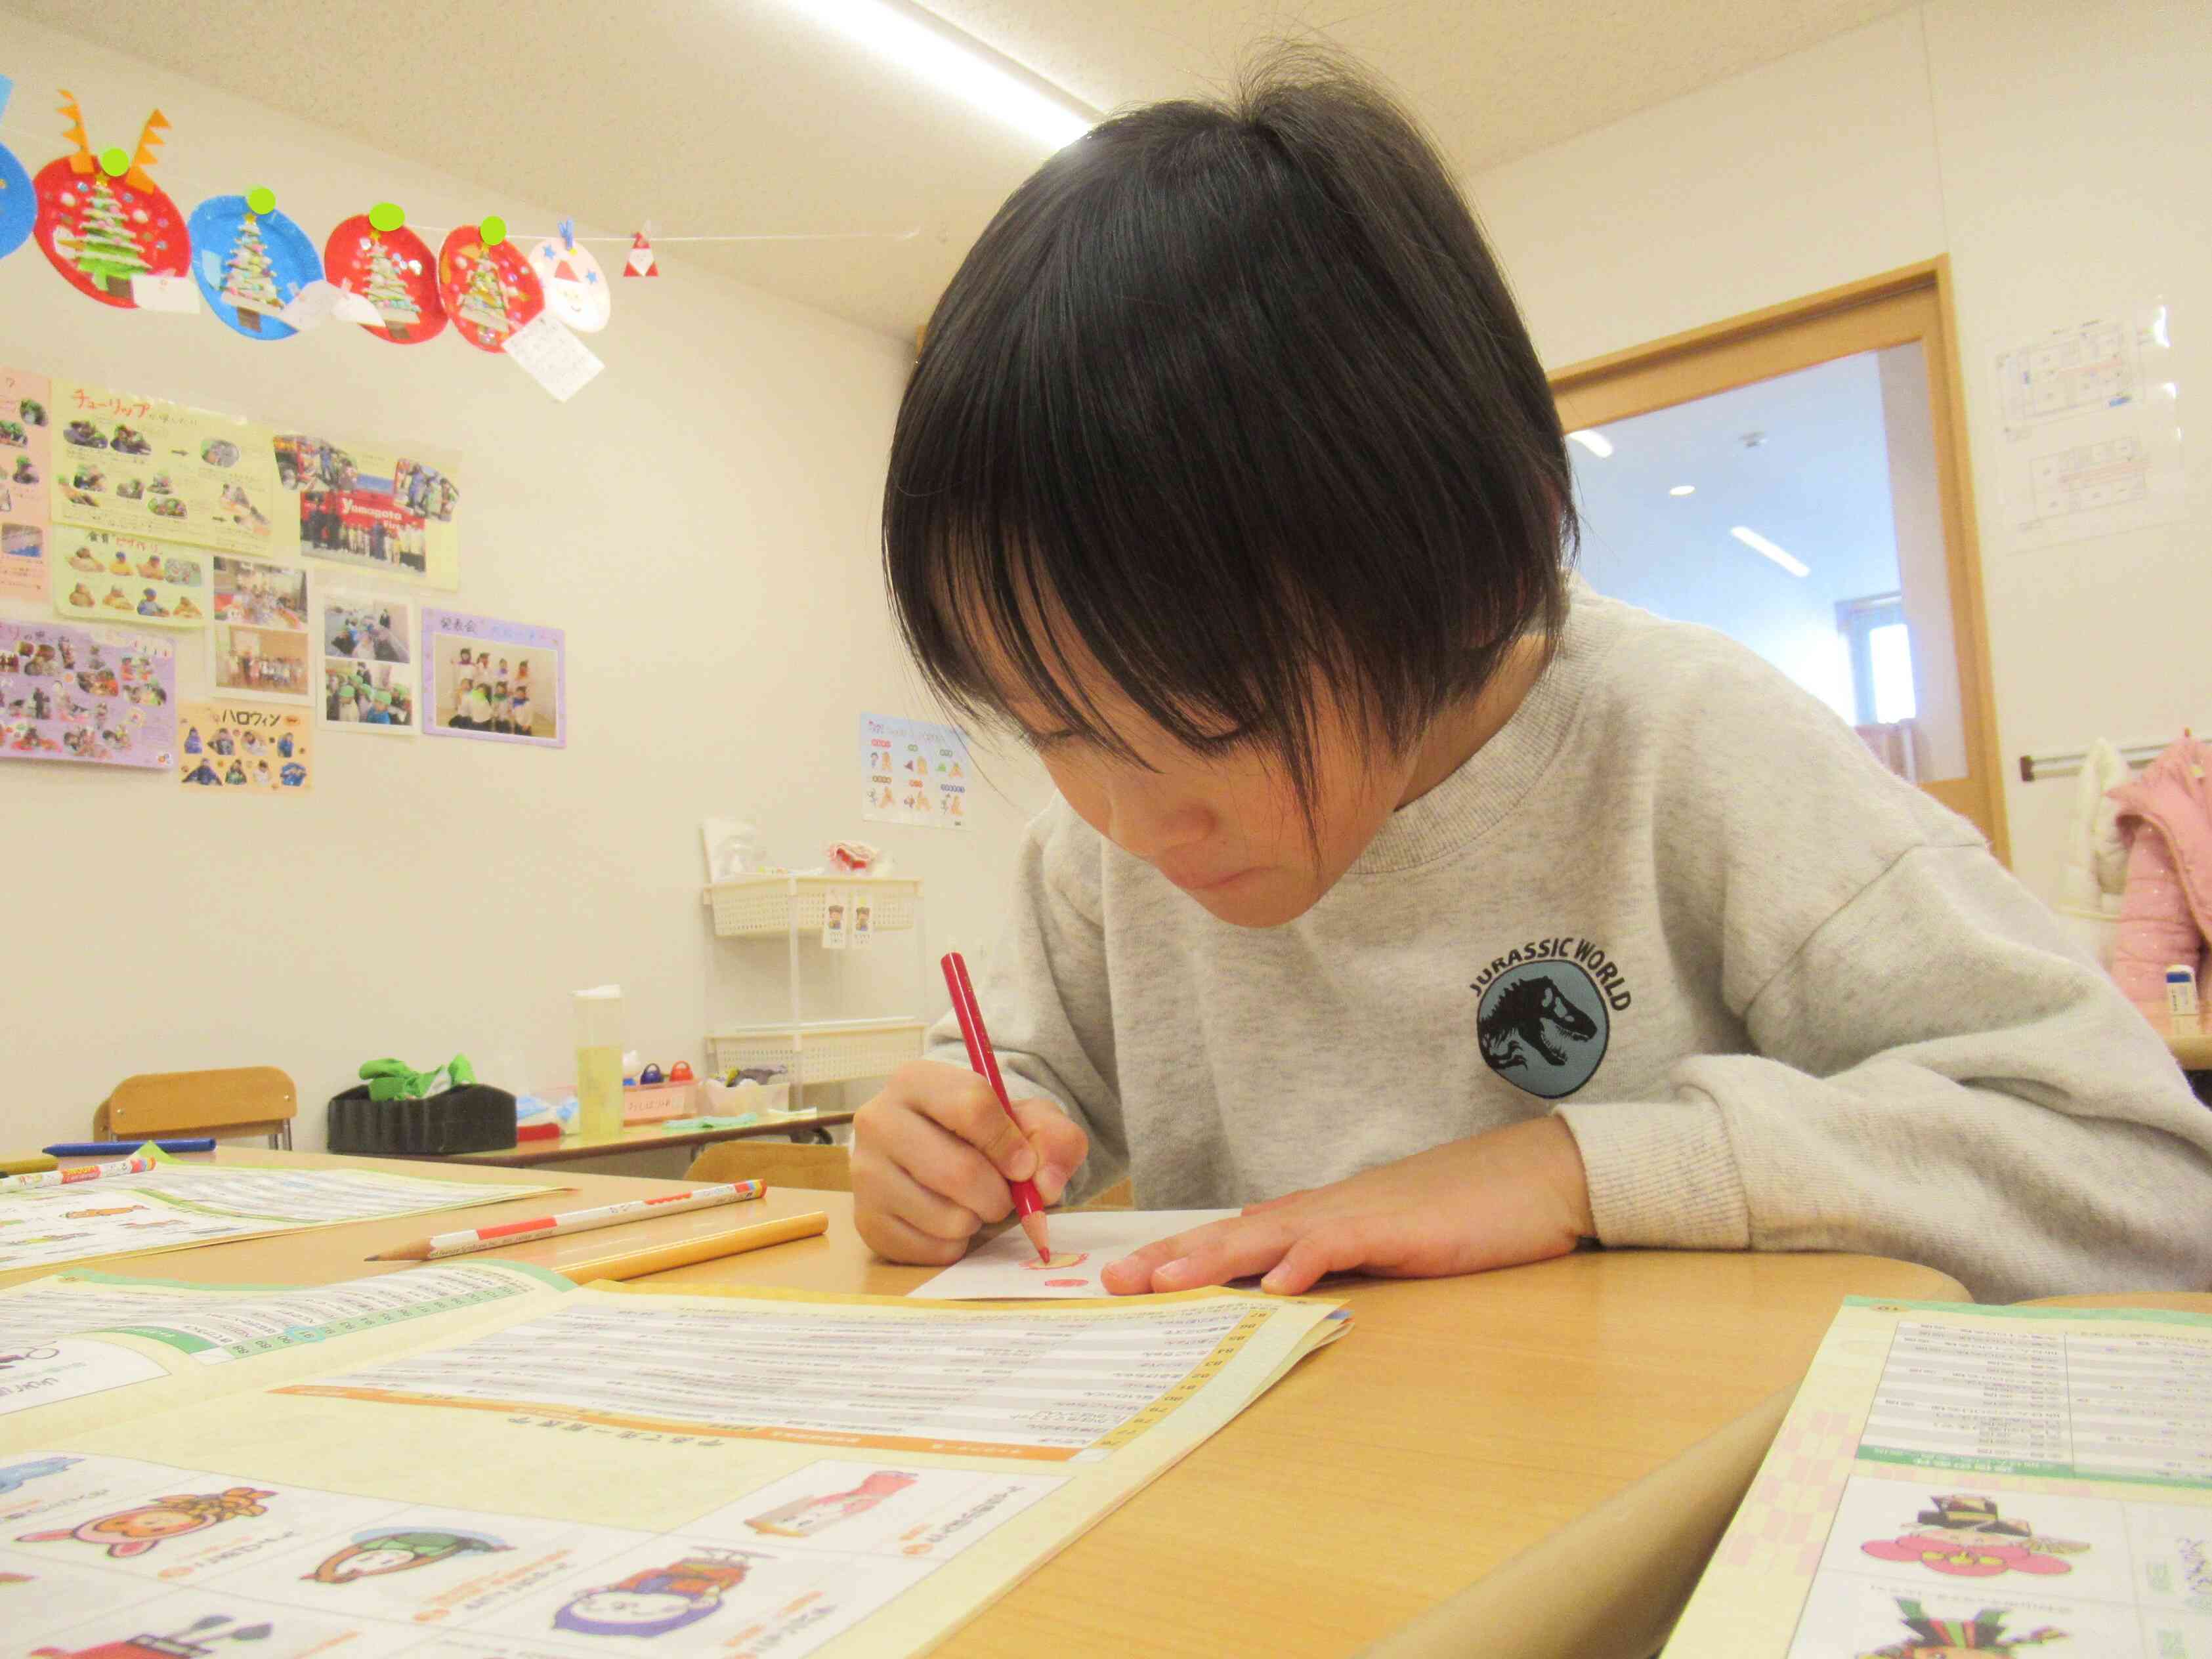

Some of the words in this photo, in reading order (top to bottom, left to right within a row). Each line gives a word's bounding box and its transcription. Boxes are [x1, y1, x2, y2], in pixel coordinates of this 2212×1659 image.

[222, 709, 282, 727] ハロウィン
[1469, 937, 1574, 998] JURASSIC
[1574, 938, 1632, 1011] WORLD
